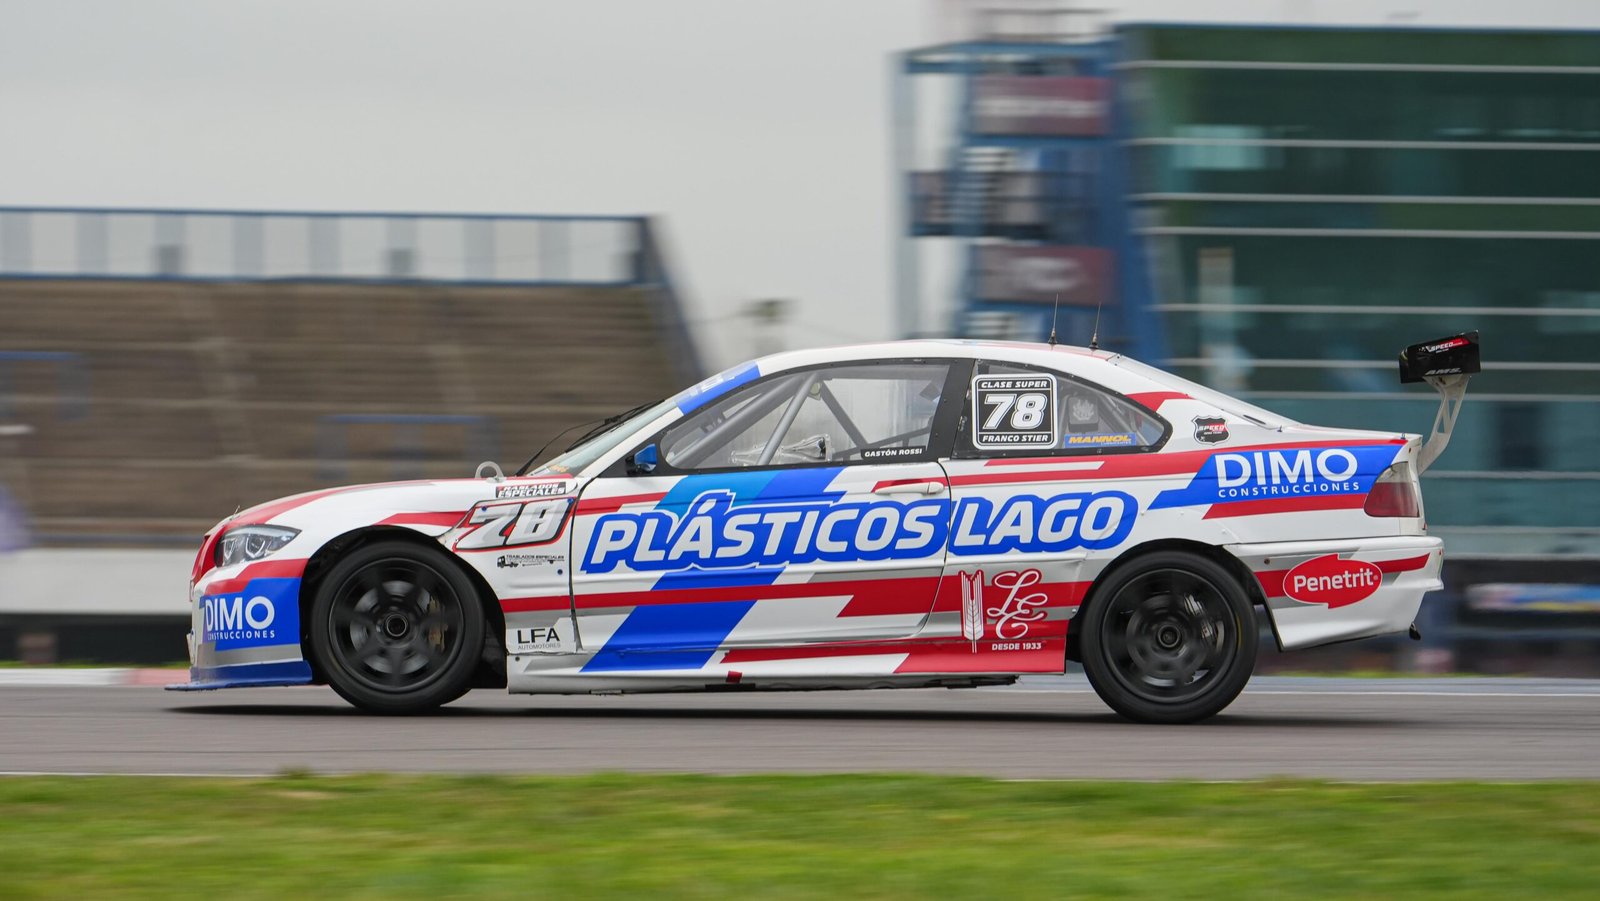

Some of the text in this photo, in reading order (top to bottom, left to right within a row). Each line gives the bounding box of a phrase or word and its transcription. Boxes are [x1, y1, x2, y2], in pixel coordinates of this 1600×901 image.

[981, 380, 1048, 389] CLASE SUPER
[982, 393, 1048, 430] 78
[1199, 424, 1225, 432] SPEED
[1021, 434, 1049, 442] STIER
[1069, 434, 1130, 444] MANNOL
[864, 448, 923, 458] GASTÓN ROSSI
[1215, 449, 1358, 488] DIMO
[498, 487, 566, 498] ESPECIALES
[1218, 482, 1360, 498] CONSTRUCCIONES
[454, 498, 574, 551] 78
[589, 496, 1125, 565] PLÁSTICOS LAGO
[1293, 568, 1374, 593] Penetrit
[205, 595, 275, 632] DIMO
[517, 627, 561, 644] LFA
[517, 643, 561, 651] AUTOMOTORES
[992, 642, 1042, 651] DESDE 1933
